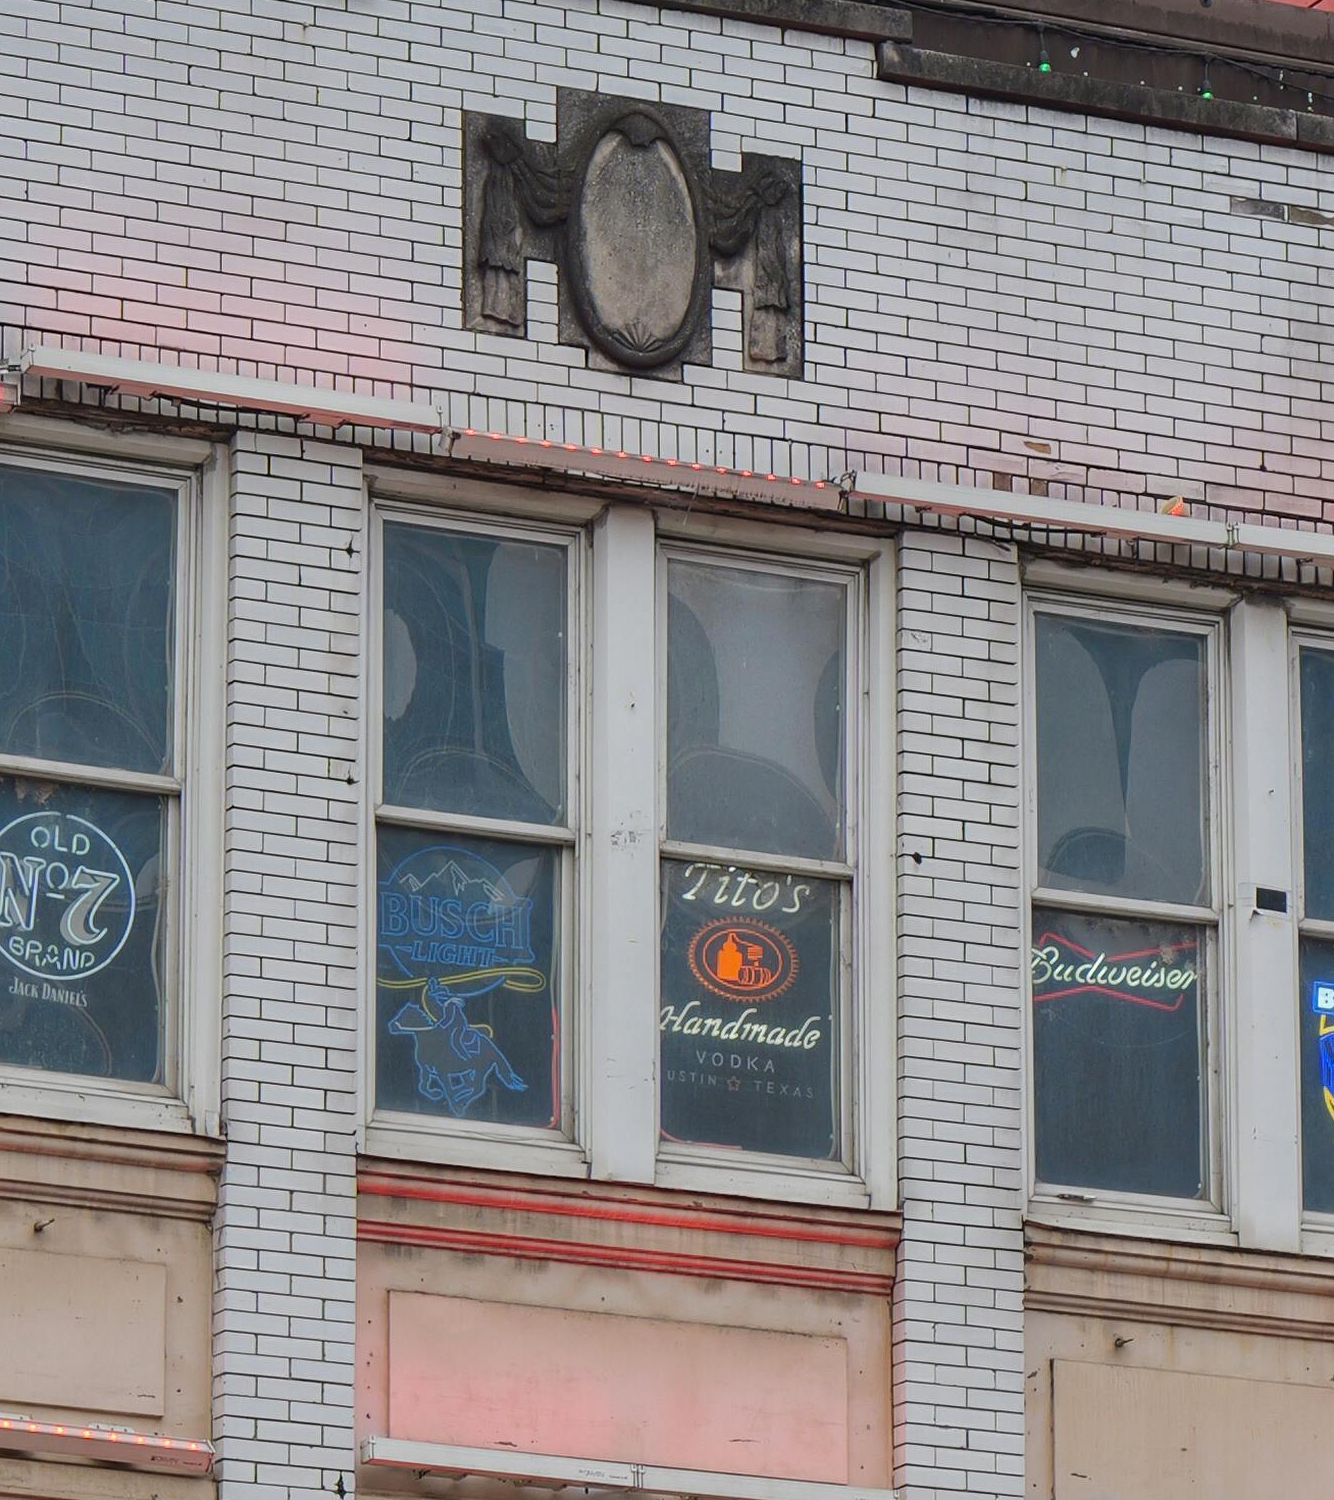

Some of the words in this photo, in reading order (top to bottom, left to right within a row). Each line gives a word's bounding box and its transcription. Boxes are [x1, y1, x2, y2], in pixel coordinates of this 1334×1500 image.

[30, 825, 90, 856] OLD
[681, 862, 811, 914] Tito's
[380, 891, 534, 952] BUSCH
[8, 935, 96, 971] BRAND
[410, 938, 497, 968] LIGHT
[1032, 946, 1198, 991] Budweiser
[8, 976, 39, 1000] JACK
[41, 980, 89, 1008] DANIEL'S
[660, 1000, 822, 1050] Handmade
[695, 1049, 777, 1074] VODKA
[667, 1070, 719, 1088] USTIN
[753, 1079, 815, 1099] TEXAS
